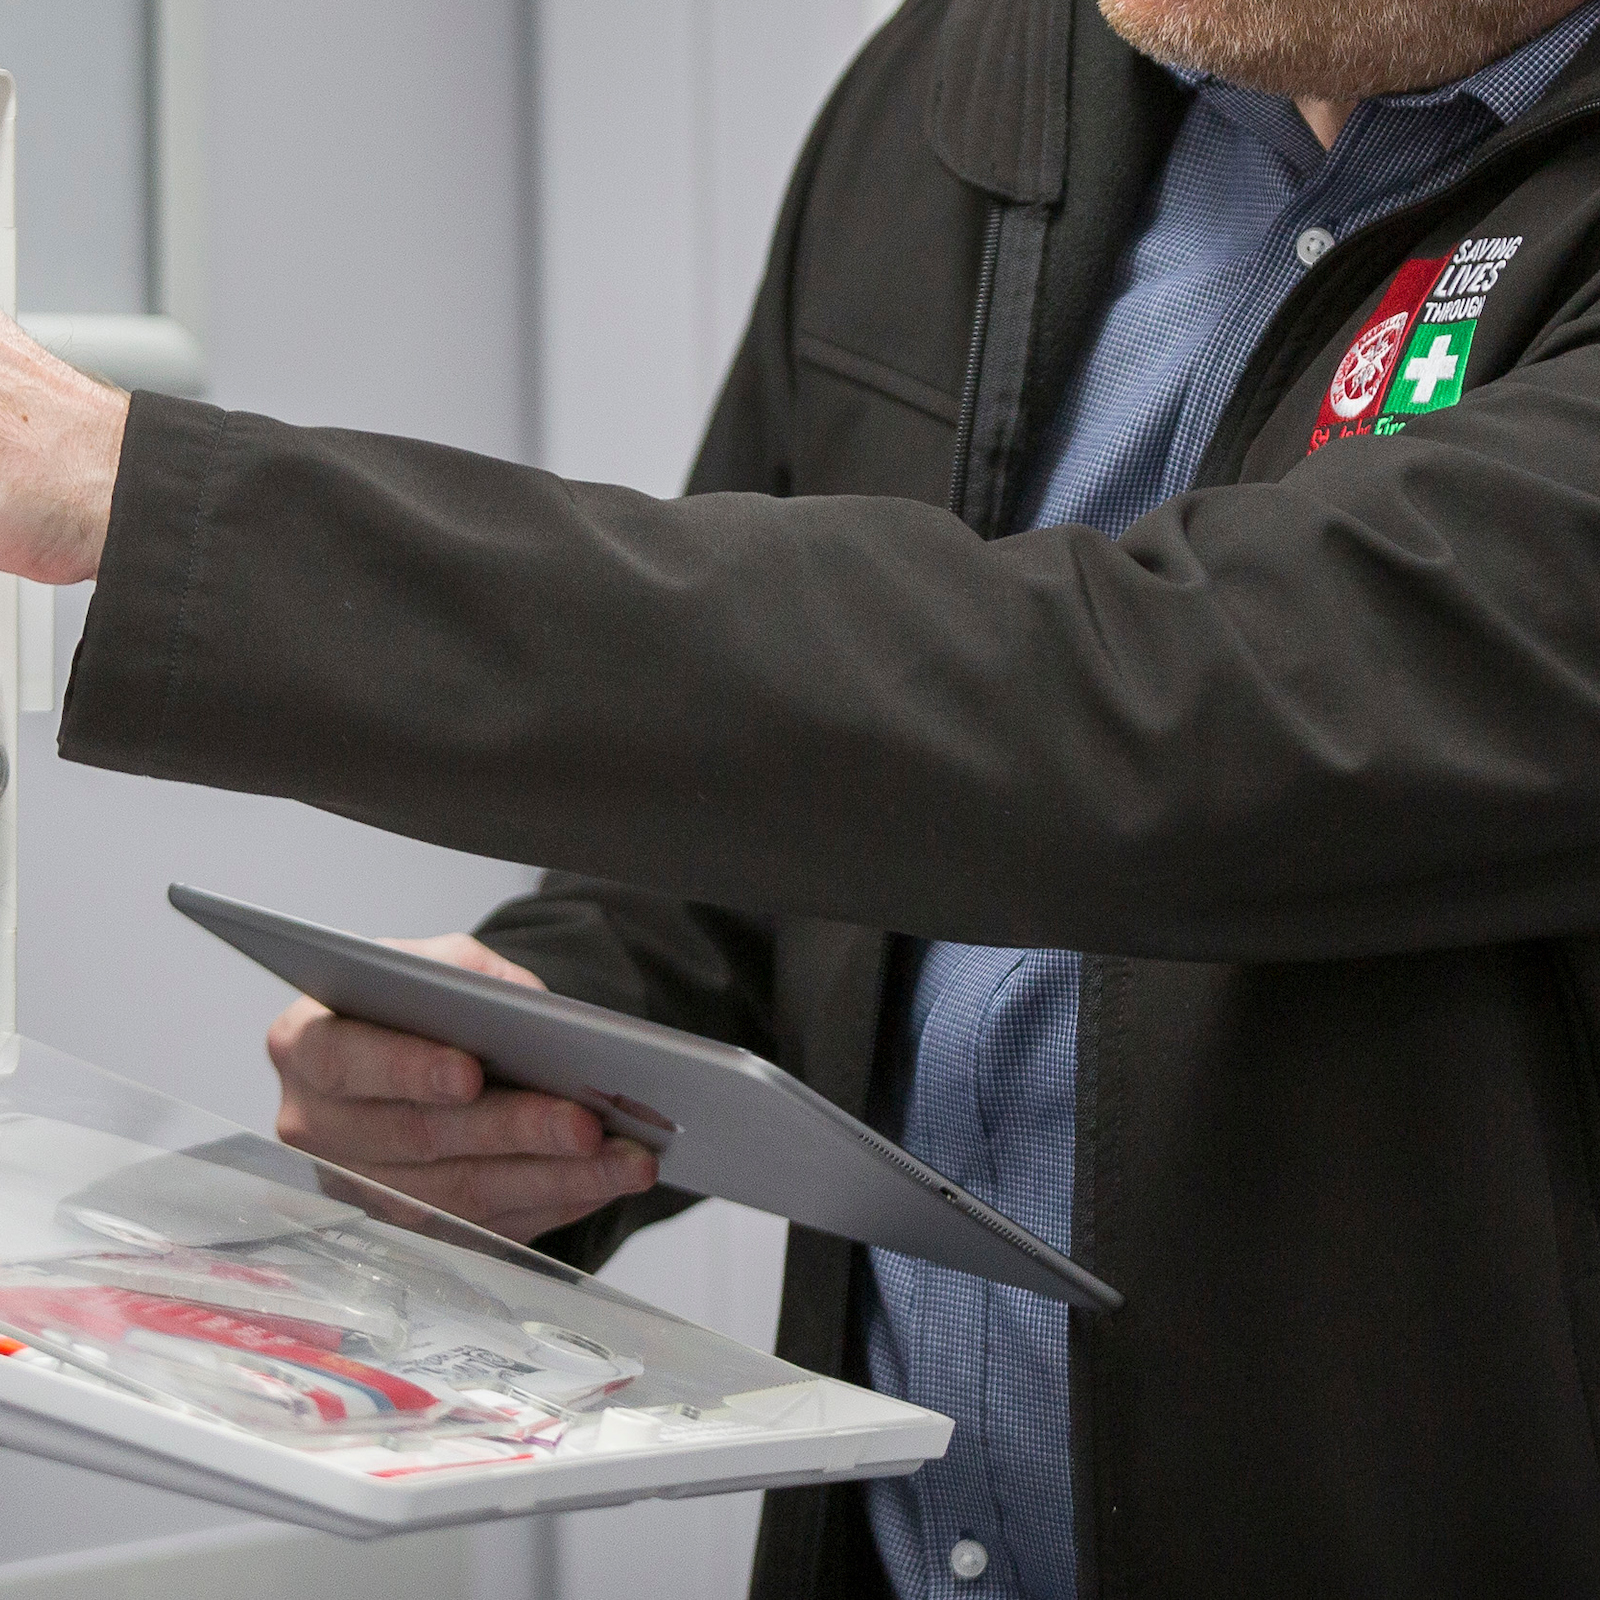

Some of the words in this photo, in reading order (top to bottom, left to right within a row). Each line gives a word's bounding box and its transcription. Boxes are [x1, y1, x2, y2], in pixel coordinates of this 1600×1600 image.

[1453, 236, 1523, 264] SAVING
[1433, 260, 1507, 297] LIVES
[1423, 295, 1486, 322] THROUGH
